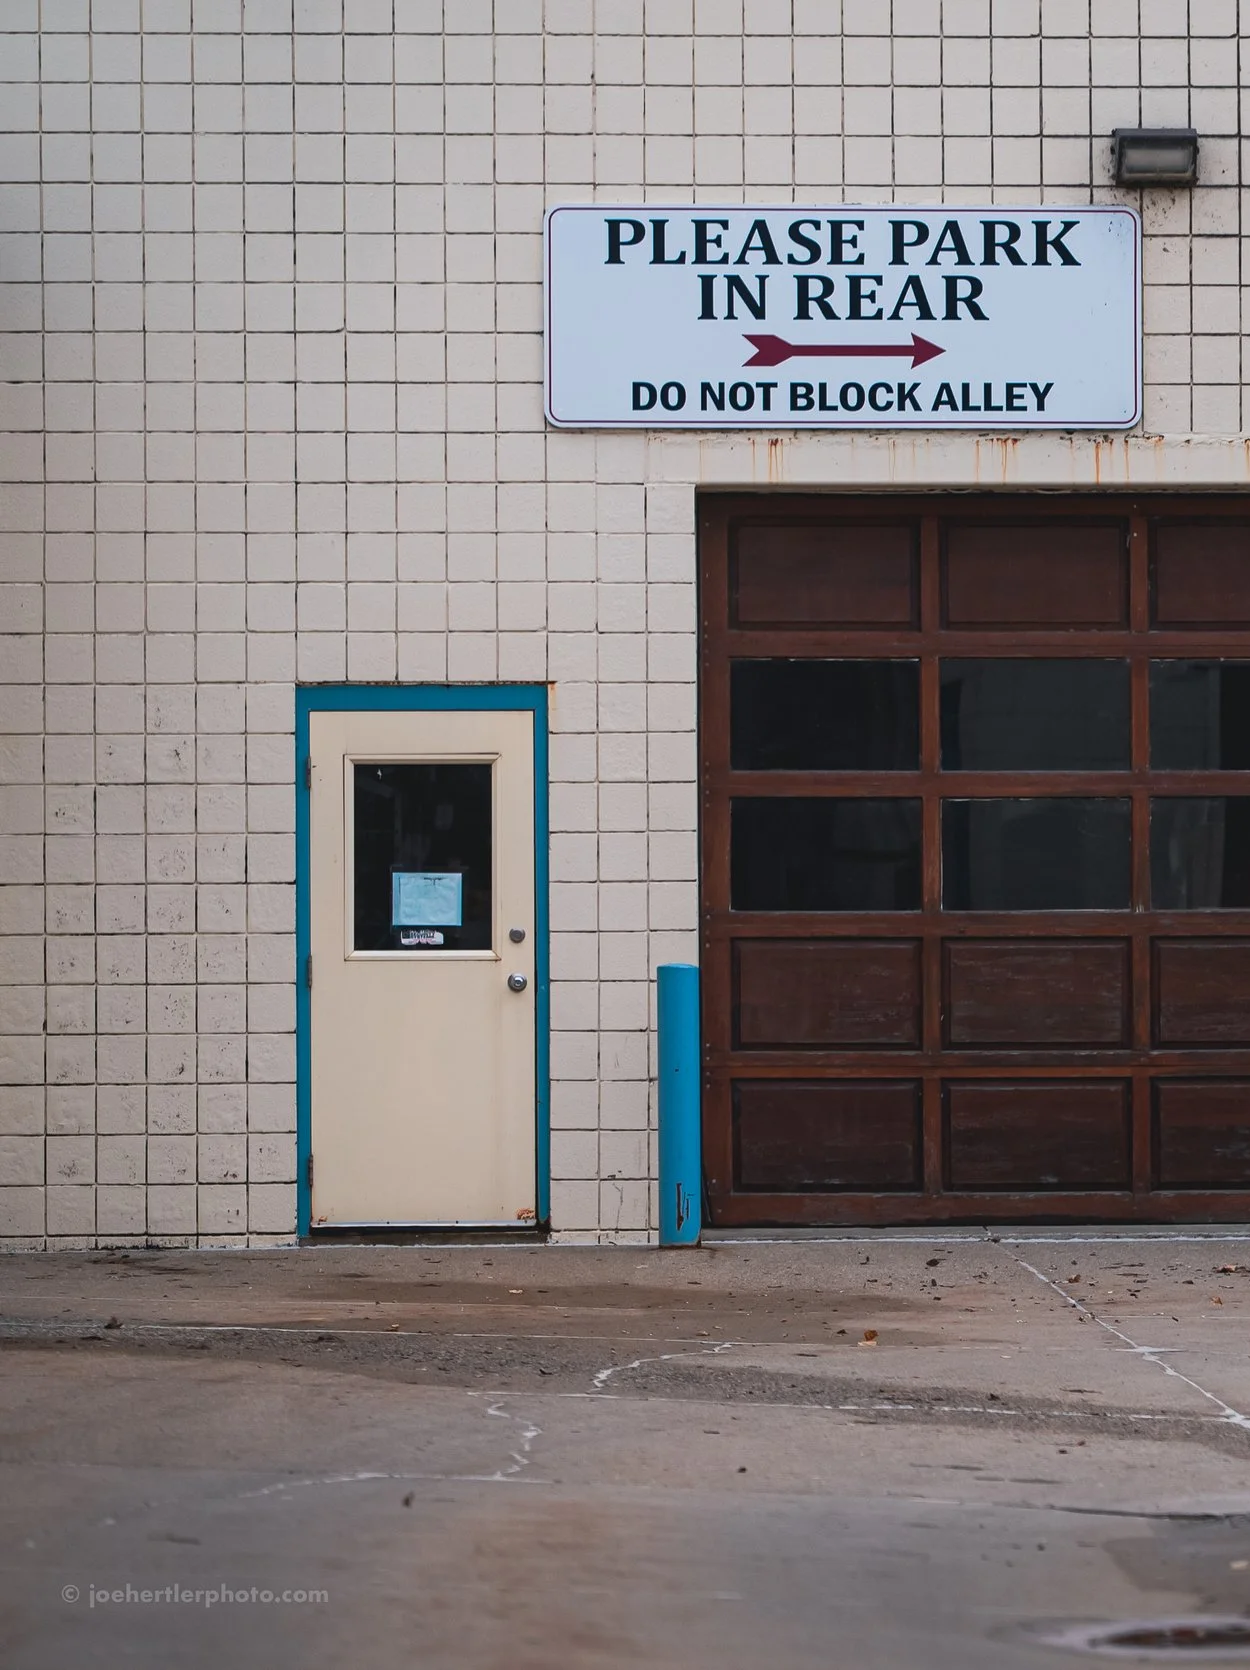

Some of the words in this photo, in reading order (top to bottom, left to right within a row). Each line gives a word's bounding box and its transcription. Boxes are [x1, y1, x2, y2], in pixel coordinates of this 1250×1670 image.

[603, 218, 865, 266] PLEASE
[887, 219, 1082, 267] PARK
[697, 274, 770, 321] IN
[792, 274, 990, 321] REAR
[632, 381, 687, 412] DO
[700, 381, 779, 412] NOT
[789, 381, 923, 412] BLOCK
[931, 382, 1055, 412] ALLEY
